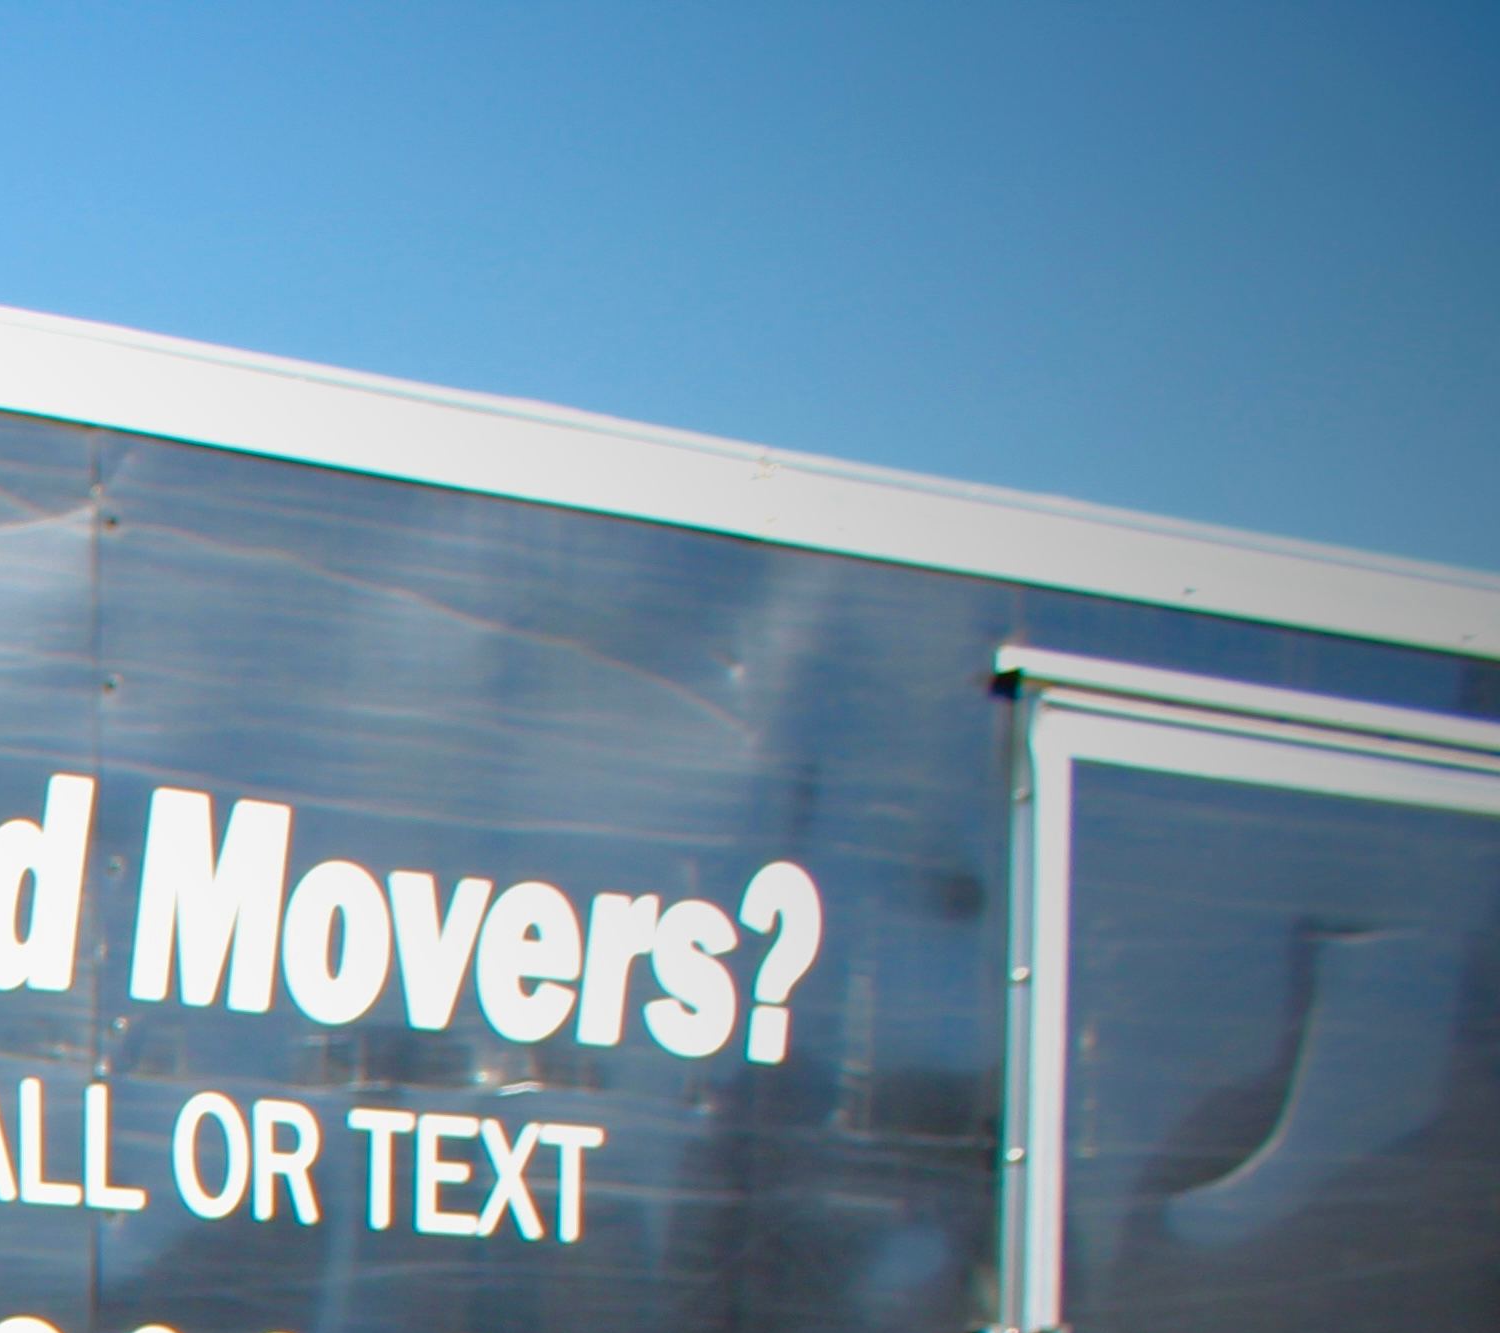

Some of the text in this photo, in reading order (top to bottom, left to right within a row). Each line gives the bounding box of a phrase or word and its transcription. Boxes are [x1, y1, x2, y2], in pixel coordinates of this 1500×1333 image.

[130, 786, 823, 1066] Movers?
[173, 1092, 319, 1224] OR
[348, 1107, 605, 1242] TEXT
